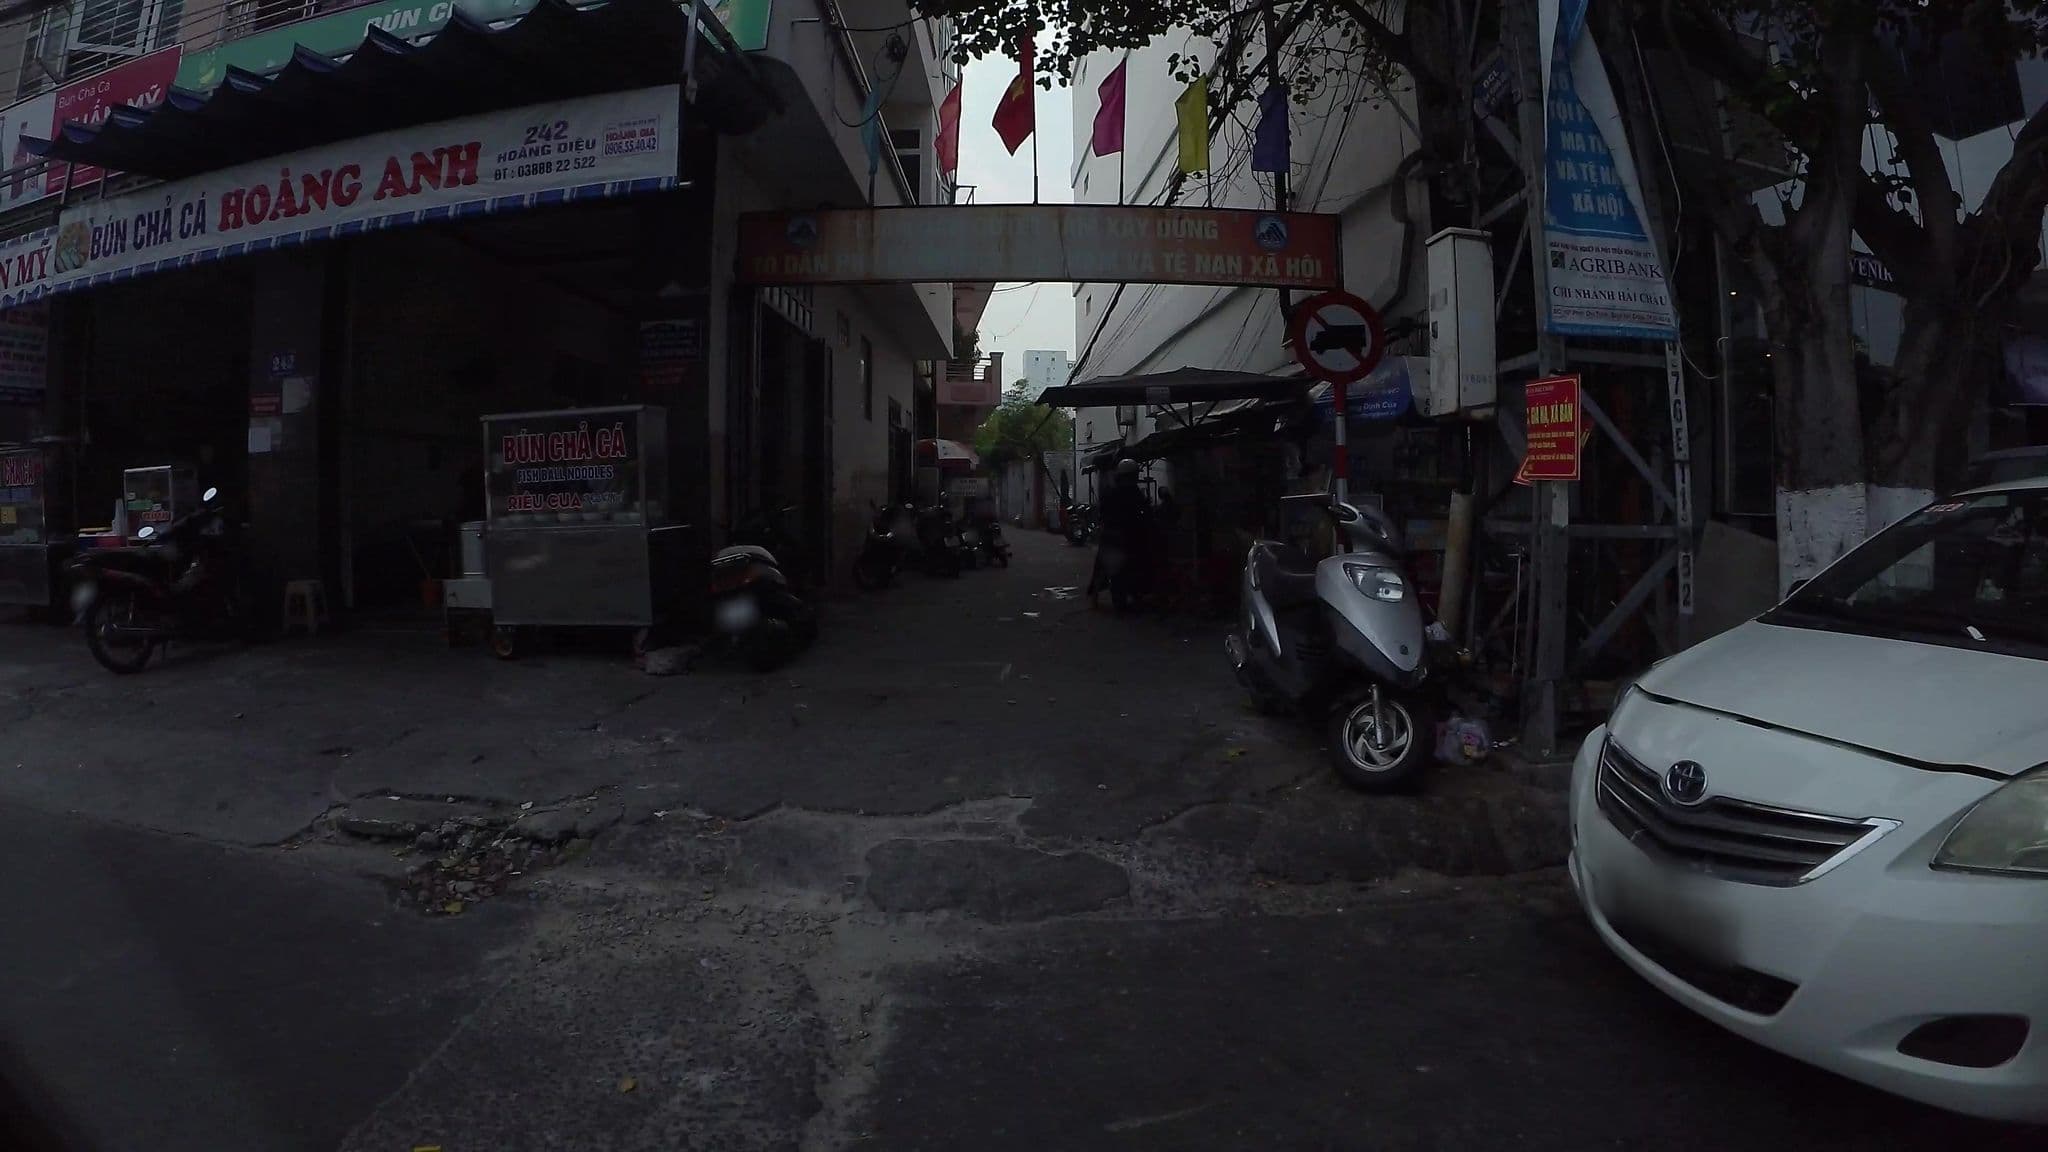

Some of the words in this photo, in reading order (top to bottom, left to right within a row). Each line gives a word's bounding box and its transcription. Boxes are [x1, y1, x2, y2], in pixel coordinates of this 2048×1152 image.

[524, 119, 569, 145] 242
[556, 159, 570, 173] 22
[573, 156, 596, 170] 522
[90, 214, 127, 260] BÚN
[134, 195, 172, 251] CHẢ
[179, 192, 206, 240] CÁ
[373, 141, 482, 200] ANH
[1286, 252, 1322, 282] HỘI
[1568, 257, 1664, 278] AGRIBANK
[1552, 286, 1572, 298] CHI
[503, 428, 545, 464] BÚN
[548, 420, 592, 461] CHẢ
[596, 422, 627, 458] CÁ
[517, 468, 542, 483] FISH
[542, 467, 566, 482] BALL
[567, 465, 614, 480] NOODLES
[547, 491, 584, 510] CUA
